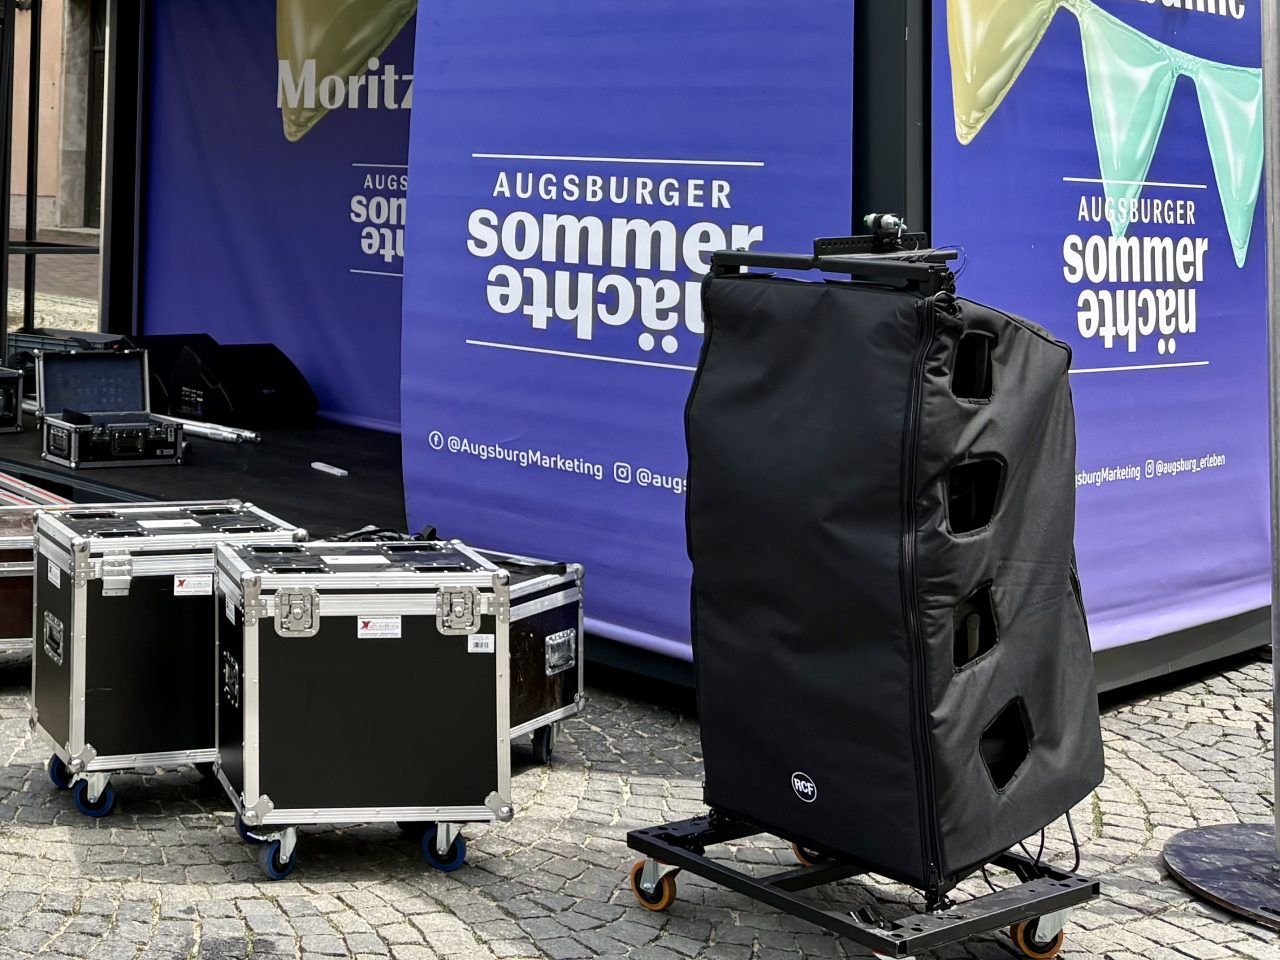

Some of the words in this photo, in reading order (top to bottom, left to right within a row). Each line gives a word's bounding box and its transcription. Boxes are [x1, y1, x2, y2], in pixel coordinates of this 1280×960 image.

[492, 171, 731, 209] AUGSBURGER
[1077, 195, 1196, 225] AUGSBURGER
[466, 208, 764, 276] sommer
[1062, 234, 1209, 284] sommer
[1076, 288, 1197, 355] nächte
[447, 435, 603, 480] @AugsburgMarketing
[1155, 452, 1226, 477] @augsburg_erleben
[793, 777, 814, 796] RCF
